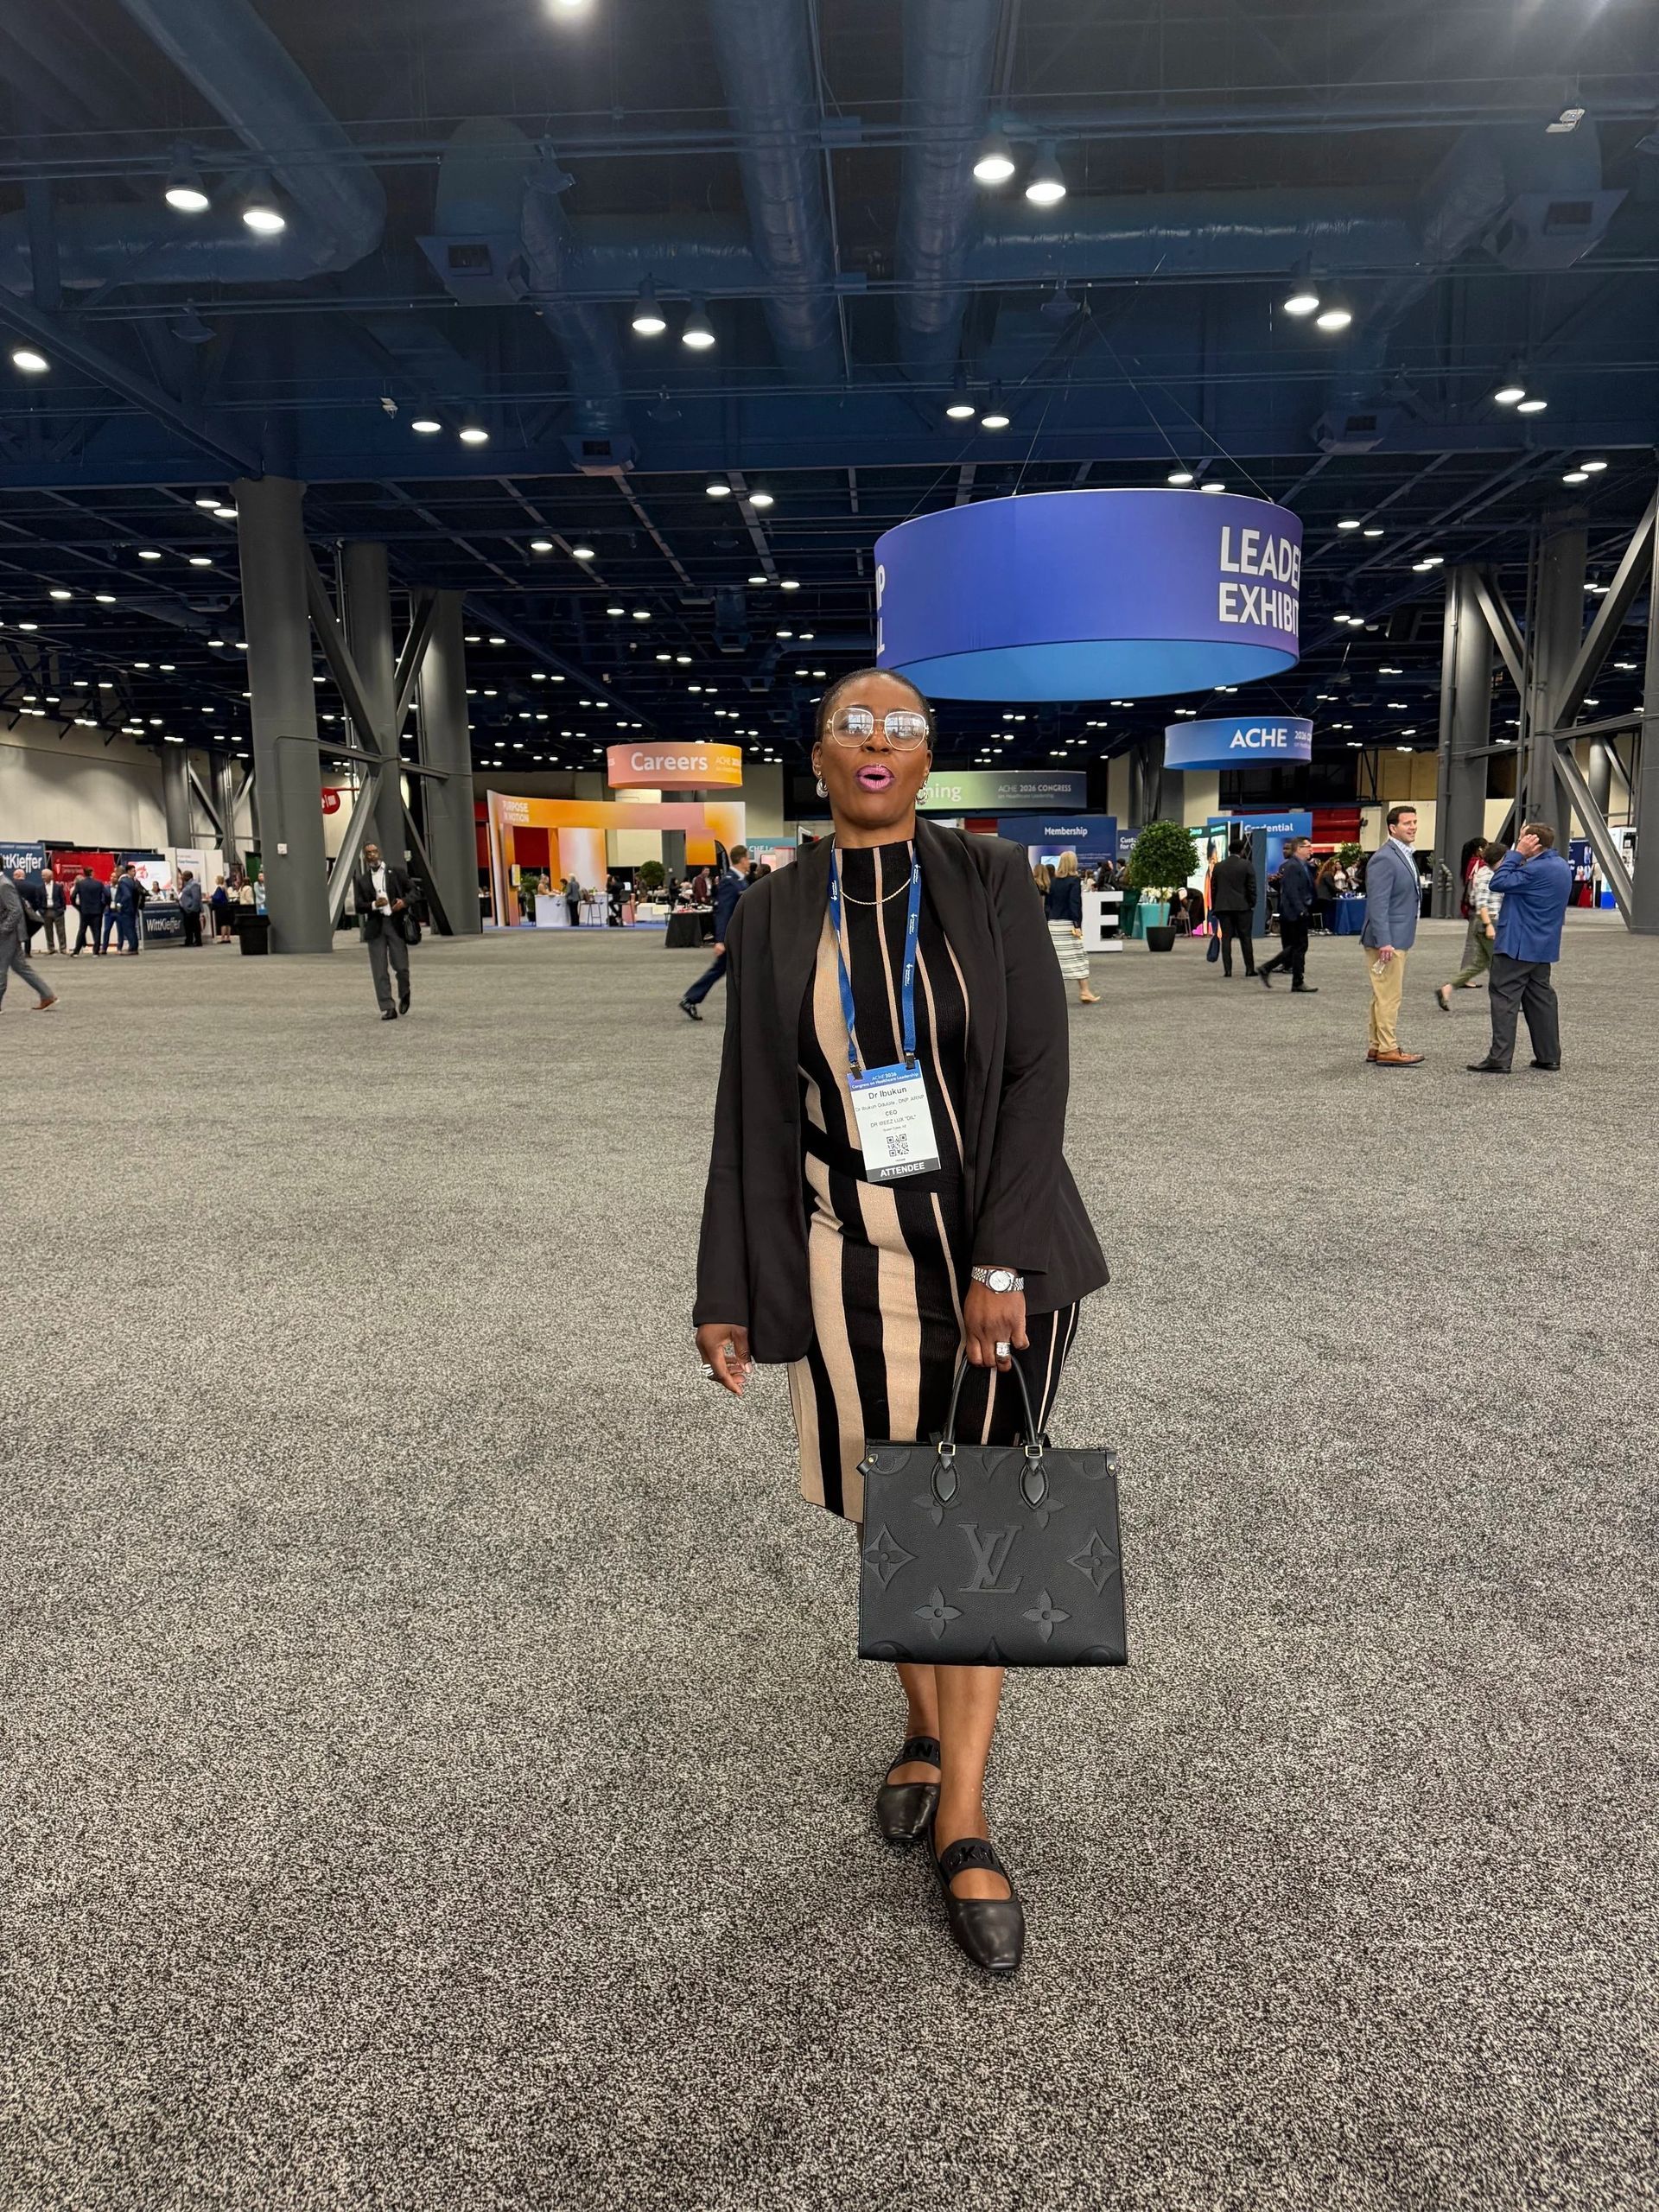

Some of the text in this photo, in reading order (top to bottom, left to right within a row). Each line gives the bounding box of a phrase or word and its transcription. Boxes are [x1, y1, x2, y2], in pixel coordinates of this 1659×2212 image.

[1220, 526, 1301, 591] LEADE
[1229, 728, 1287, 748] ACHE
[631, 752, 709, 771] Careers
[1044, 827, 1088, 836] Membership
[146, 917, 181, 933] WittKieffer
[879, 1087, 907, 1097] Ibukun
[880, 1161, 925, 1177] ATTENDEE
